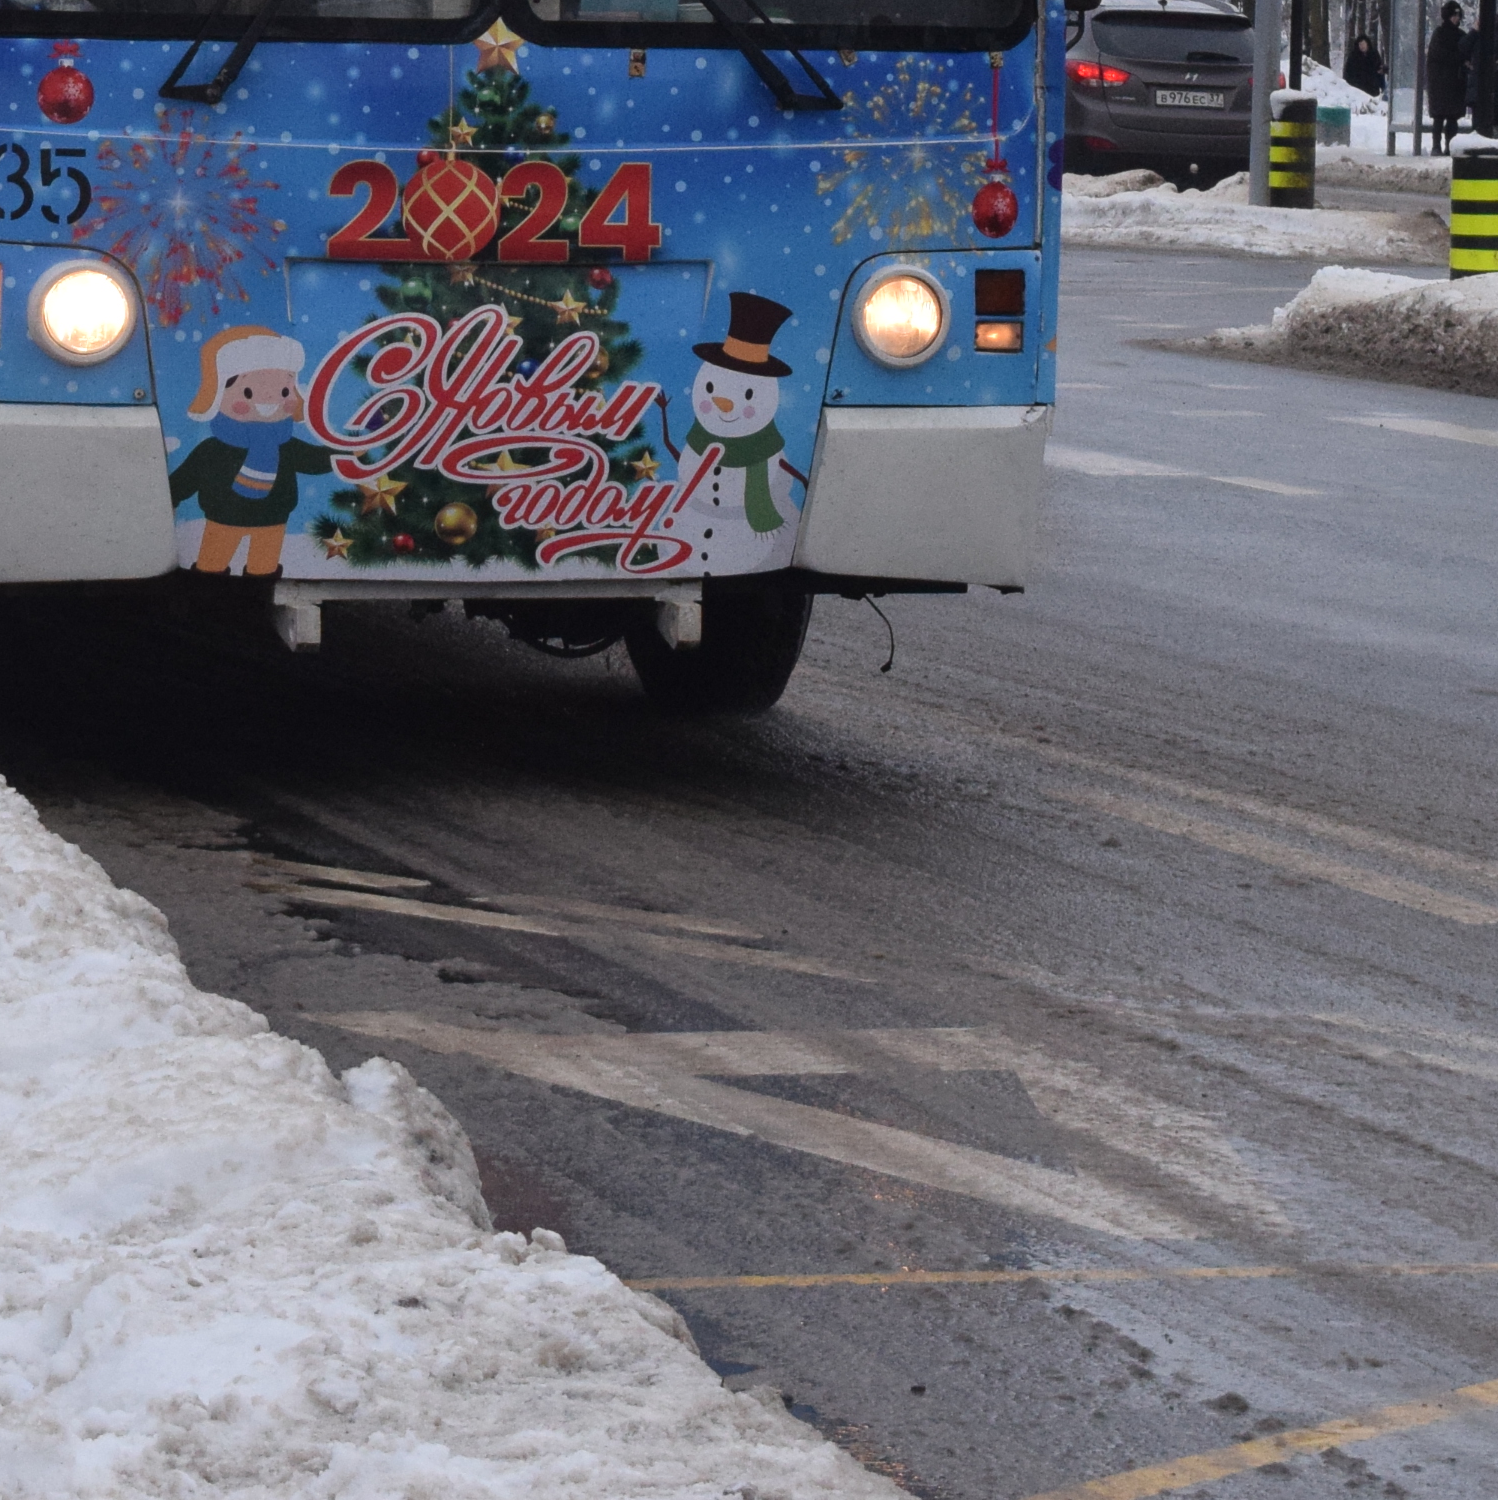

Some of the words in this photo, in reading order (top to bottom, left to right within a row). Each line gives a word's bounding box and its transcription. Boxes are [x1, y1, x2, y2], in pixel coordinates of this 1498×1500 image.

[326, 158, 663, 262] 2024
[332, 304, 662, 482] Новым
[441, 433, 726, 576] годом!
